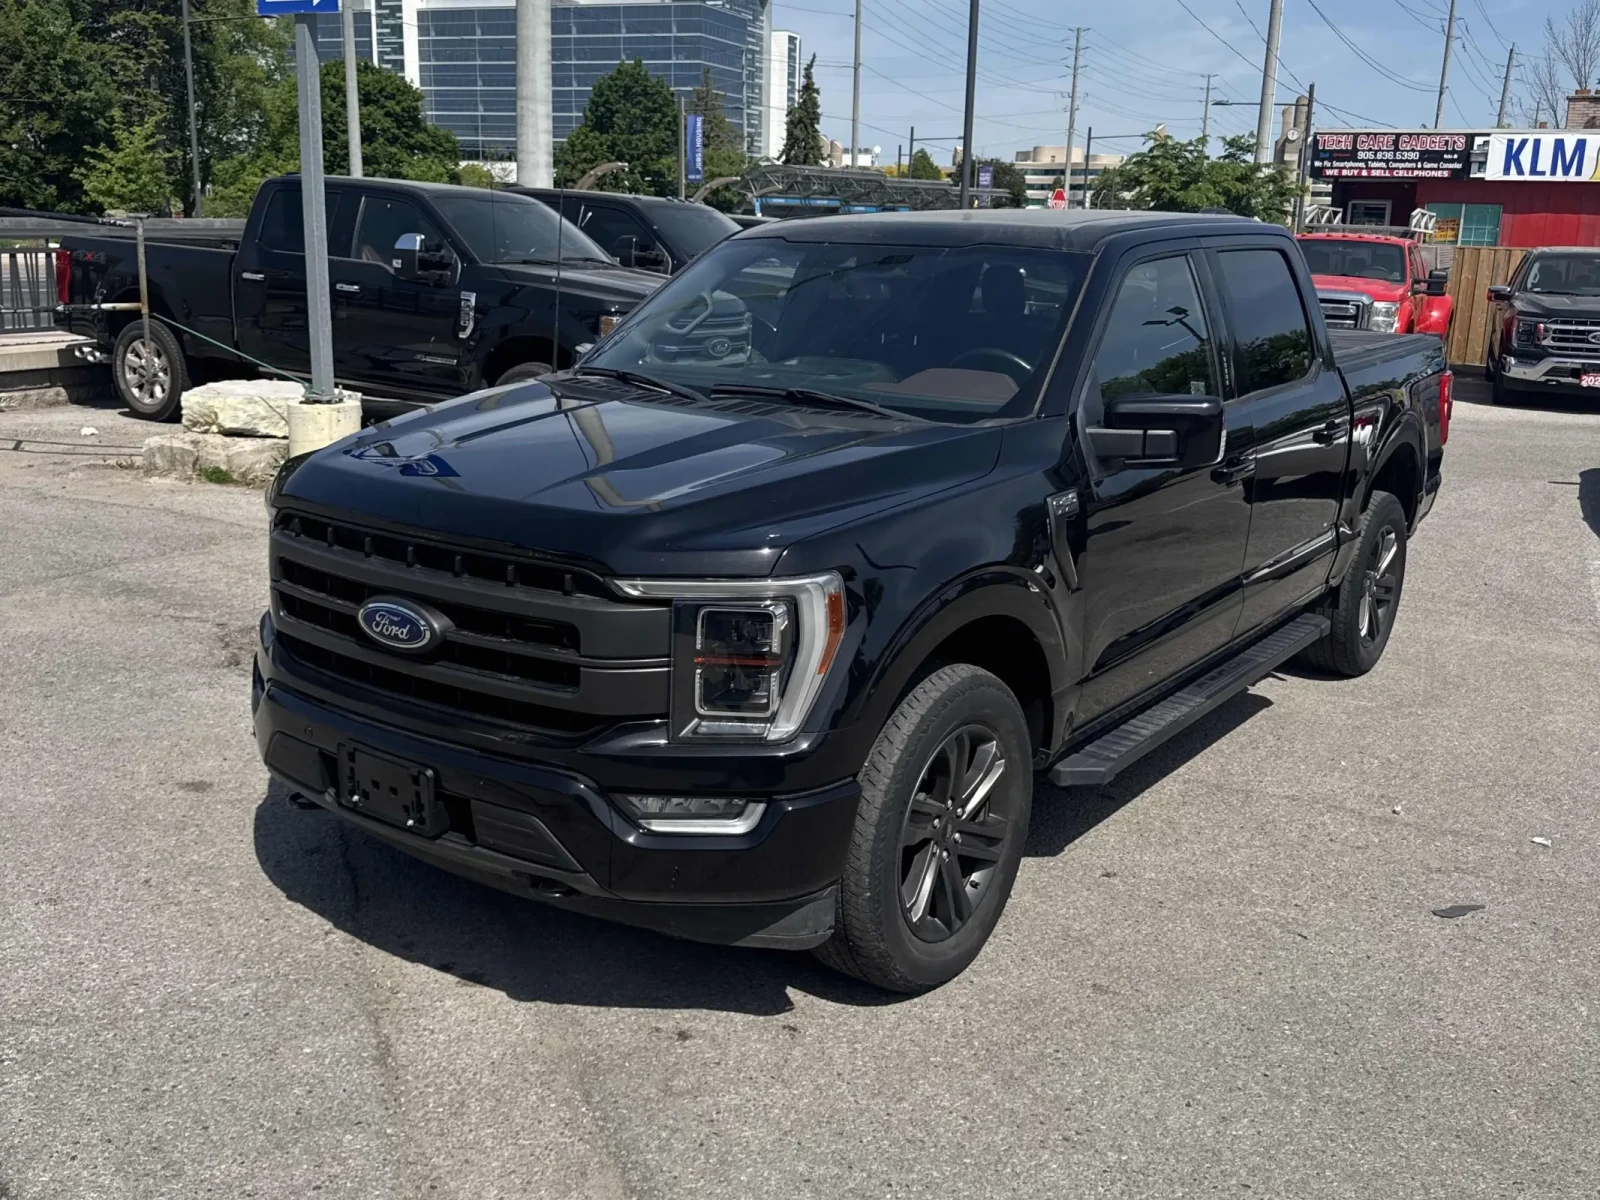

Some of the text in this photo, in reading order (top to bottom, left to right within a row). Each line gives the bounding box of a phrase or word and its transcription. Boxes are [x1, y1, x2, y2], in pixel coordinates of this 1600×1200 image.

[1317, 135, 1466, 150] TECH CARE GADGETS
[1503, 138, 1587, 176] KLM
[1371, 169, 1391, 177] SELL
[372, 611, 410, 640] Ford
